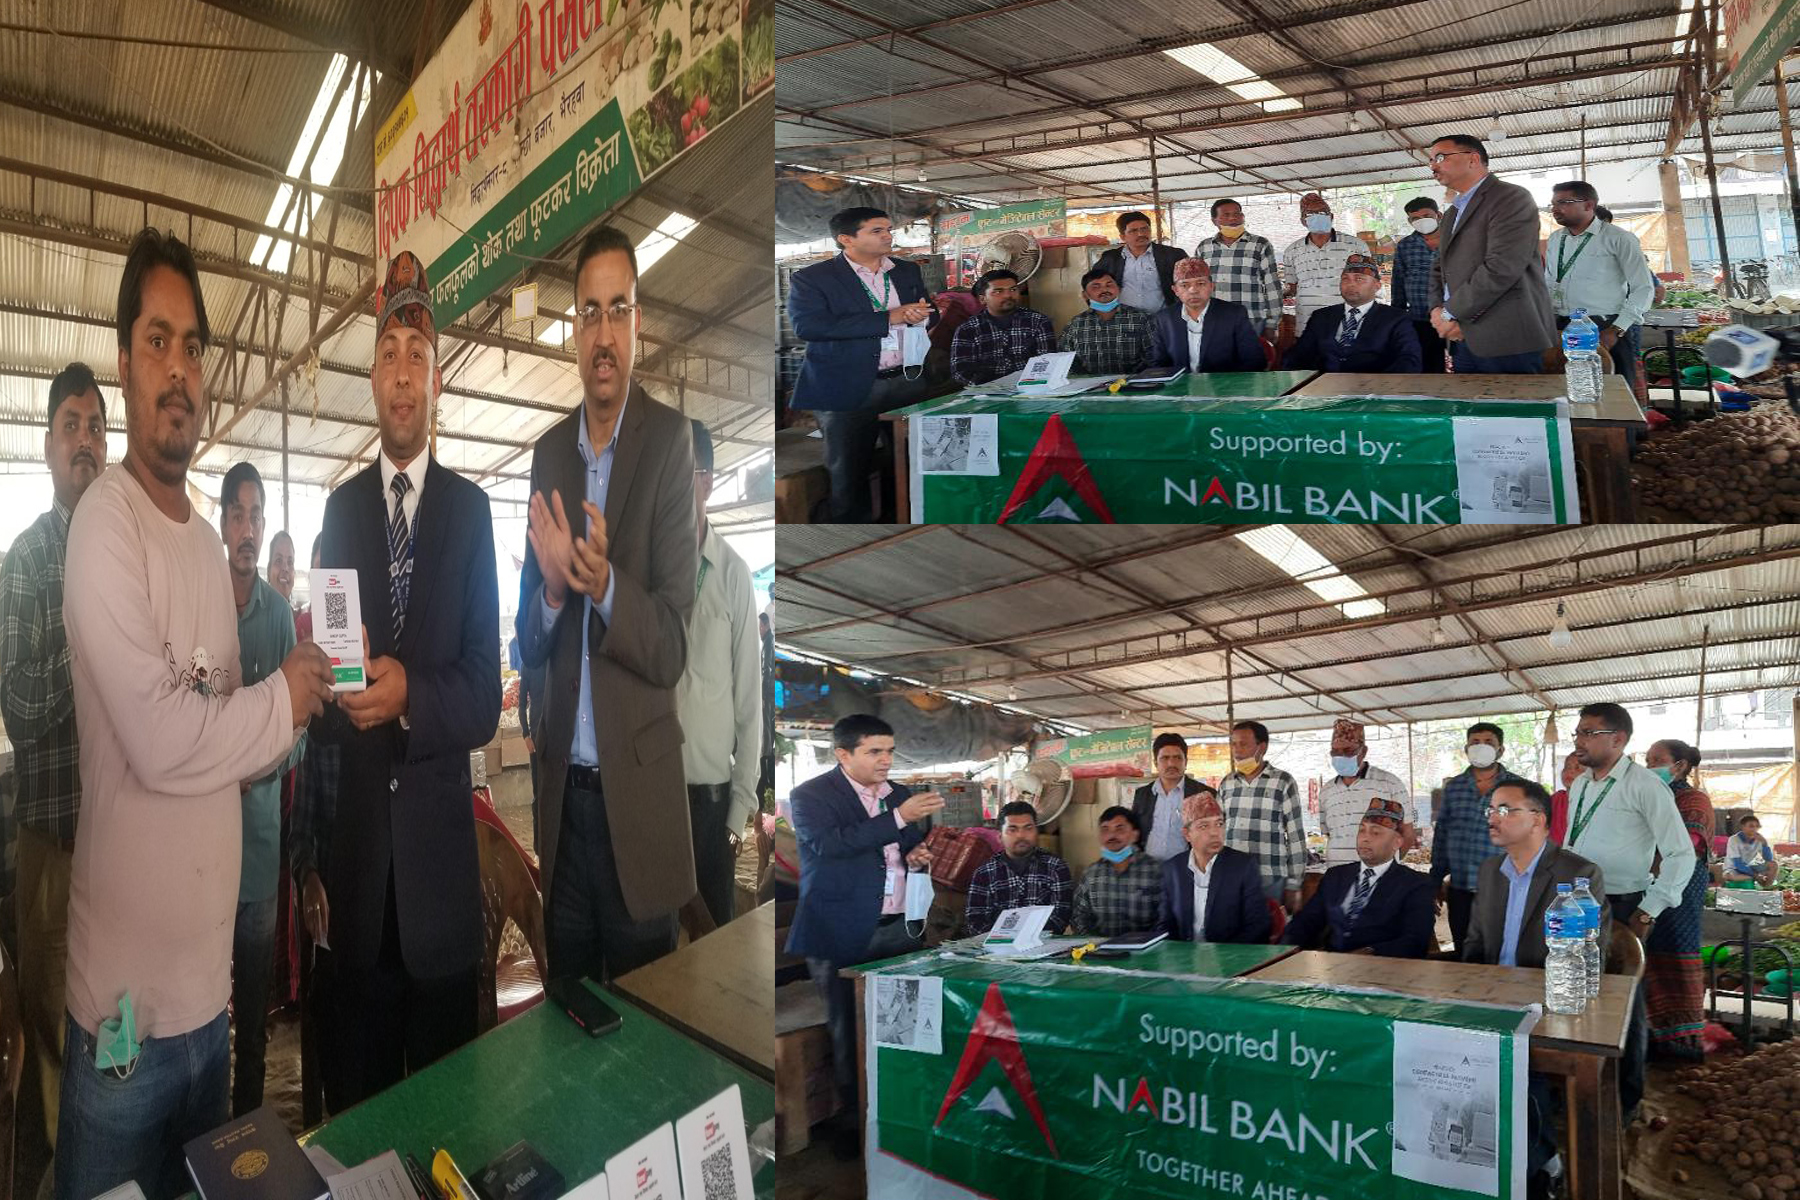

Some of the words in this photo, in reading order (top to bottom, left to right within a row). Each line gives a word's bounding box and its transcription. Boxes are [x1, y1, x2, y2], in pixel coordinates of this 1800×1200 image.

[378, 178, 410, 262] दिपक
[464, 1, 533, 164] तरकारी
[436, 243, 480, 304] फलफूलको
[482, 231, 503, 268] थोक
[505, 208, 528, 252] तथा
[576, 130, 621, 196] विक्रेता
[1210, 427, 1346, 458] Supported
[1358, 430, 1402, 464] by:
[1164, 475, 1293, 514] NABIL
[1304, 486, 1446, 524] BANK
[1140, 1013, 1278, 1062] Supported
[1290, 1031, 1337, 1079] by:
[1092, 1073, 1218, 1134] NABIL
[1230, 1100, 1379, 1171] BANK
[505, 1166, 539, 1195] Artline
[1136, 1149, 1244, 1196] TOGETHER
